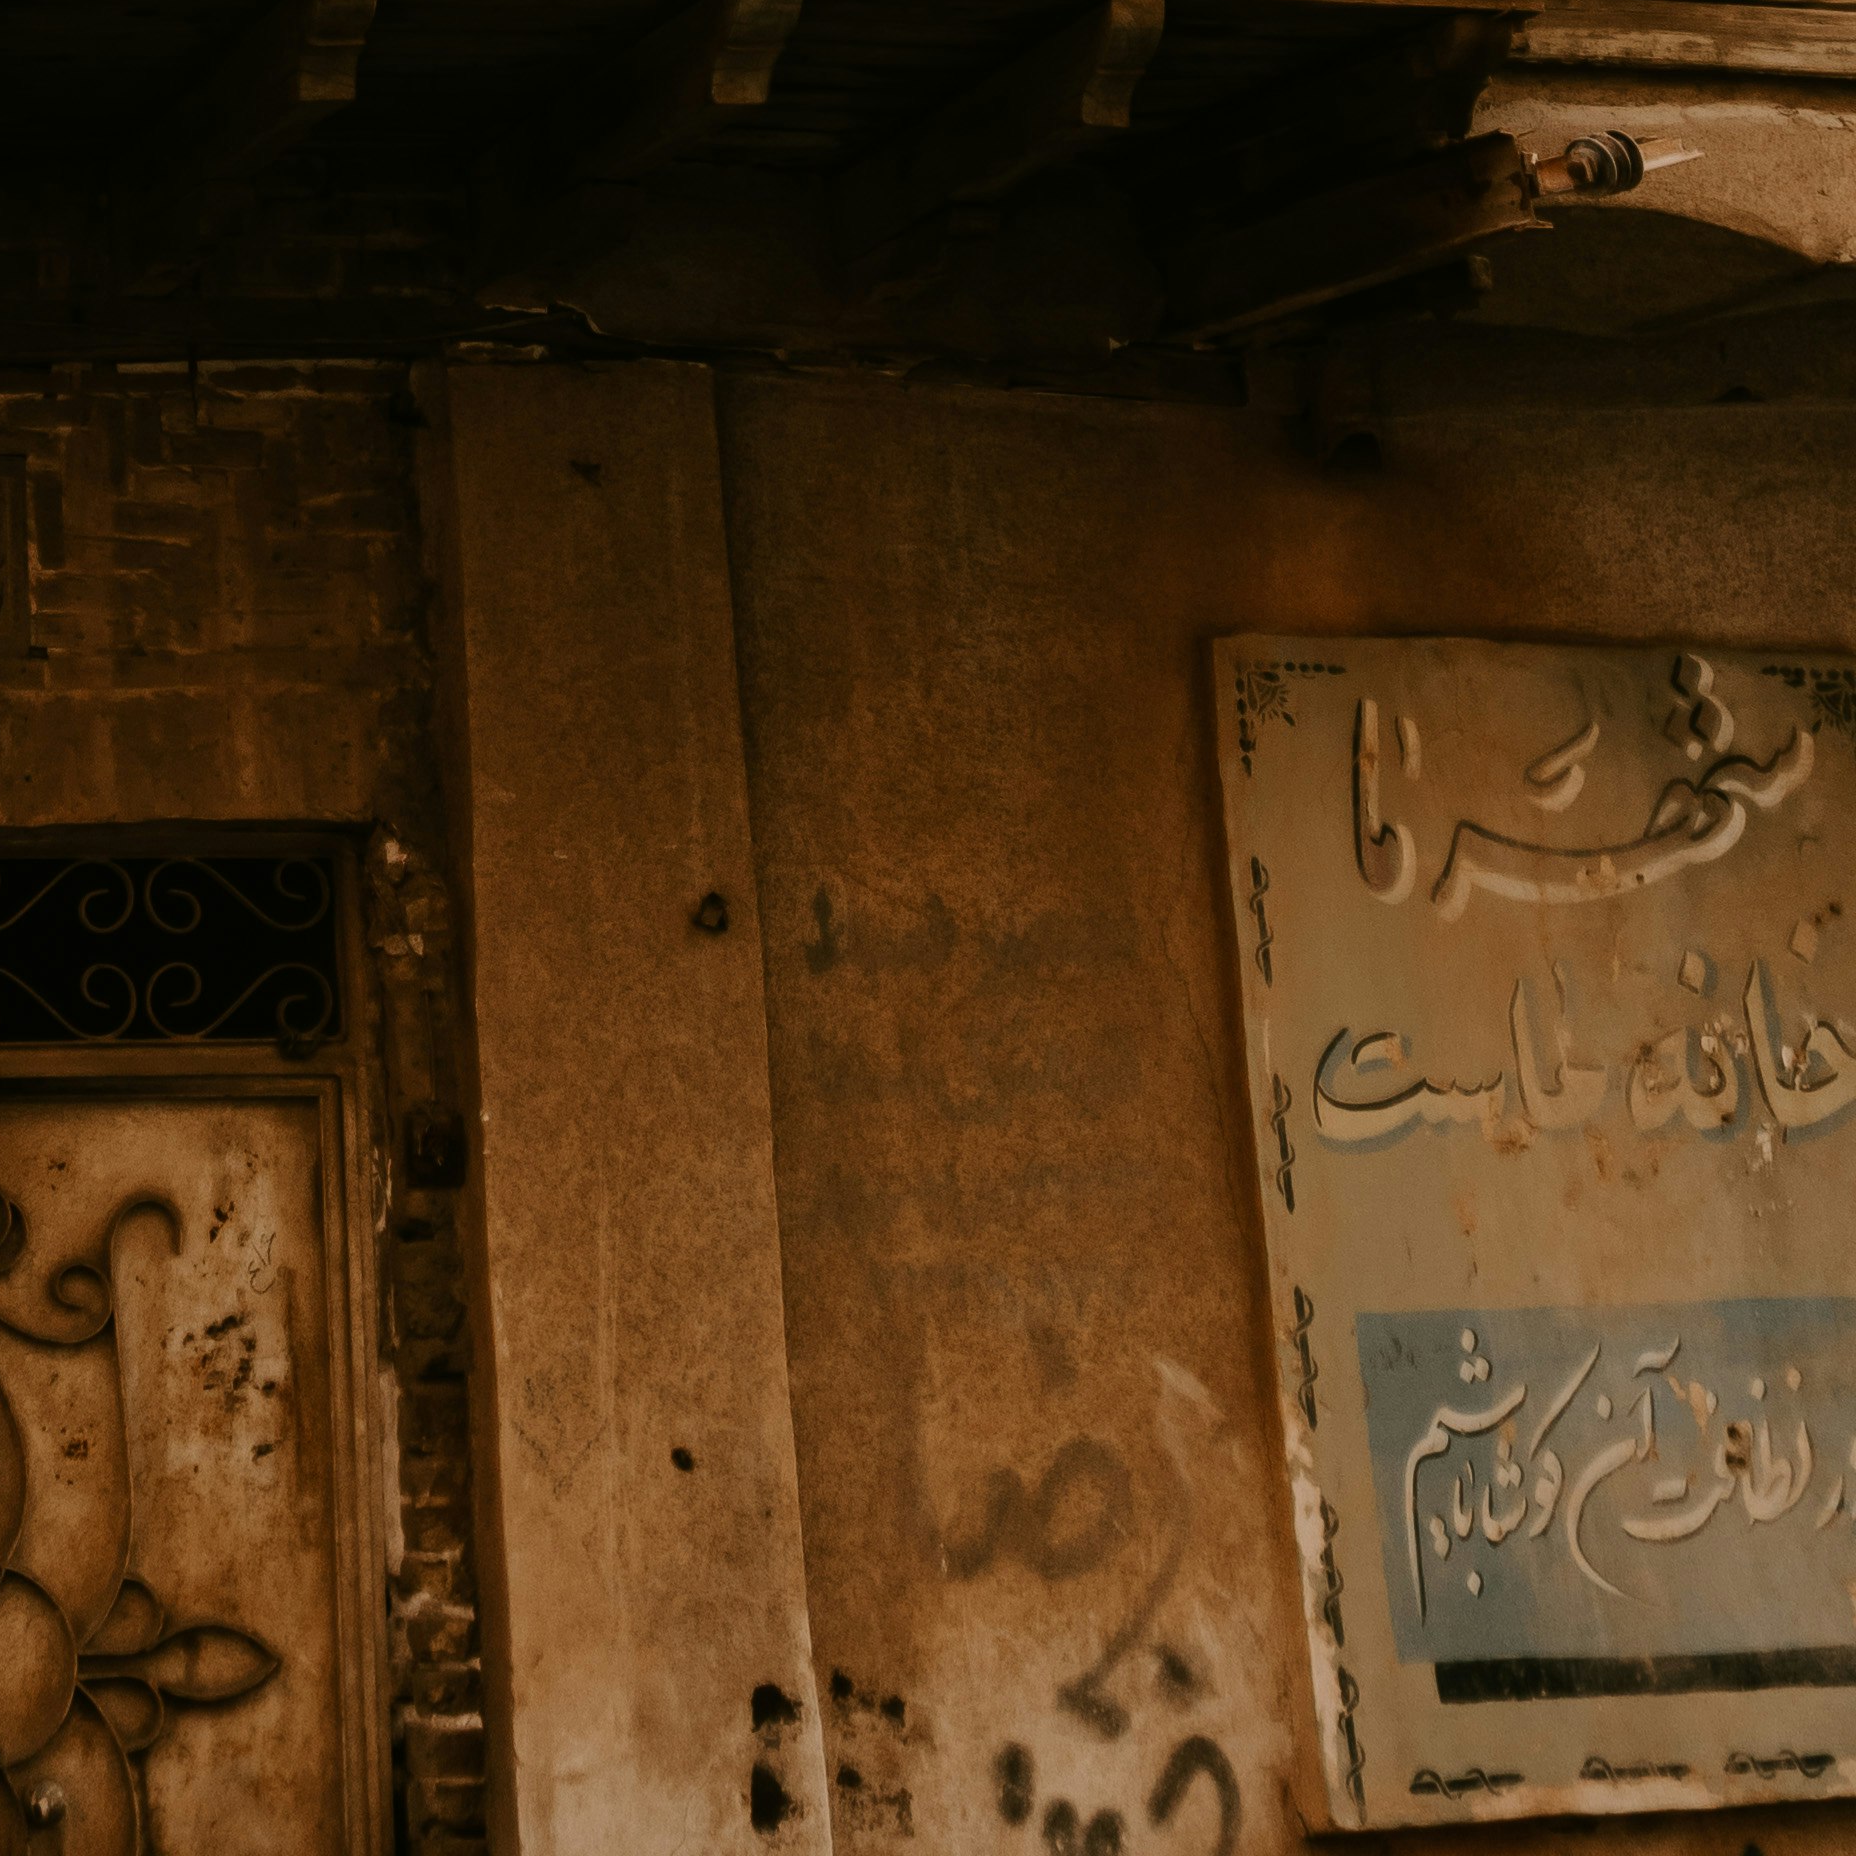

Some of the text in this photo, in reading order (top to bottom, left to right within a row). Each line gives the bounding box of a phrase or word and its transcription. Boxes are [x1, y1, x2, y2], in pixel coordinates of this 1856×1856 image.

[1351, 653, 1815, 925] شهر ما
[1404, 1327, 1528, 1629] باشیم
[1480, 1341, 1602, 1545] کوشا
[1566, 1334, 1682, 1608] آن
[1620, 1365, 1813, 1543] نظافت
